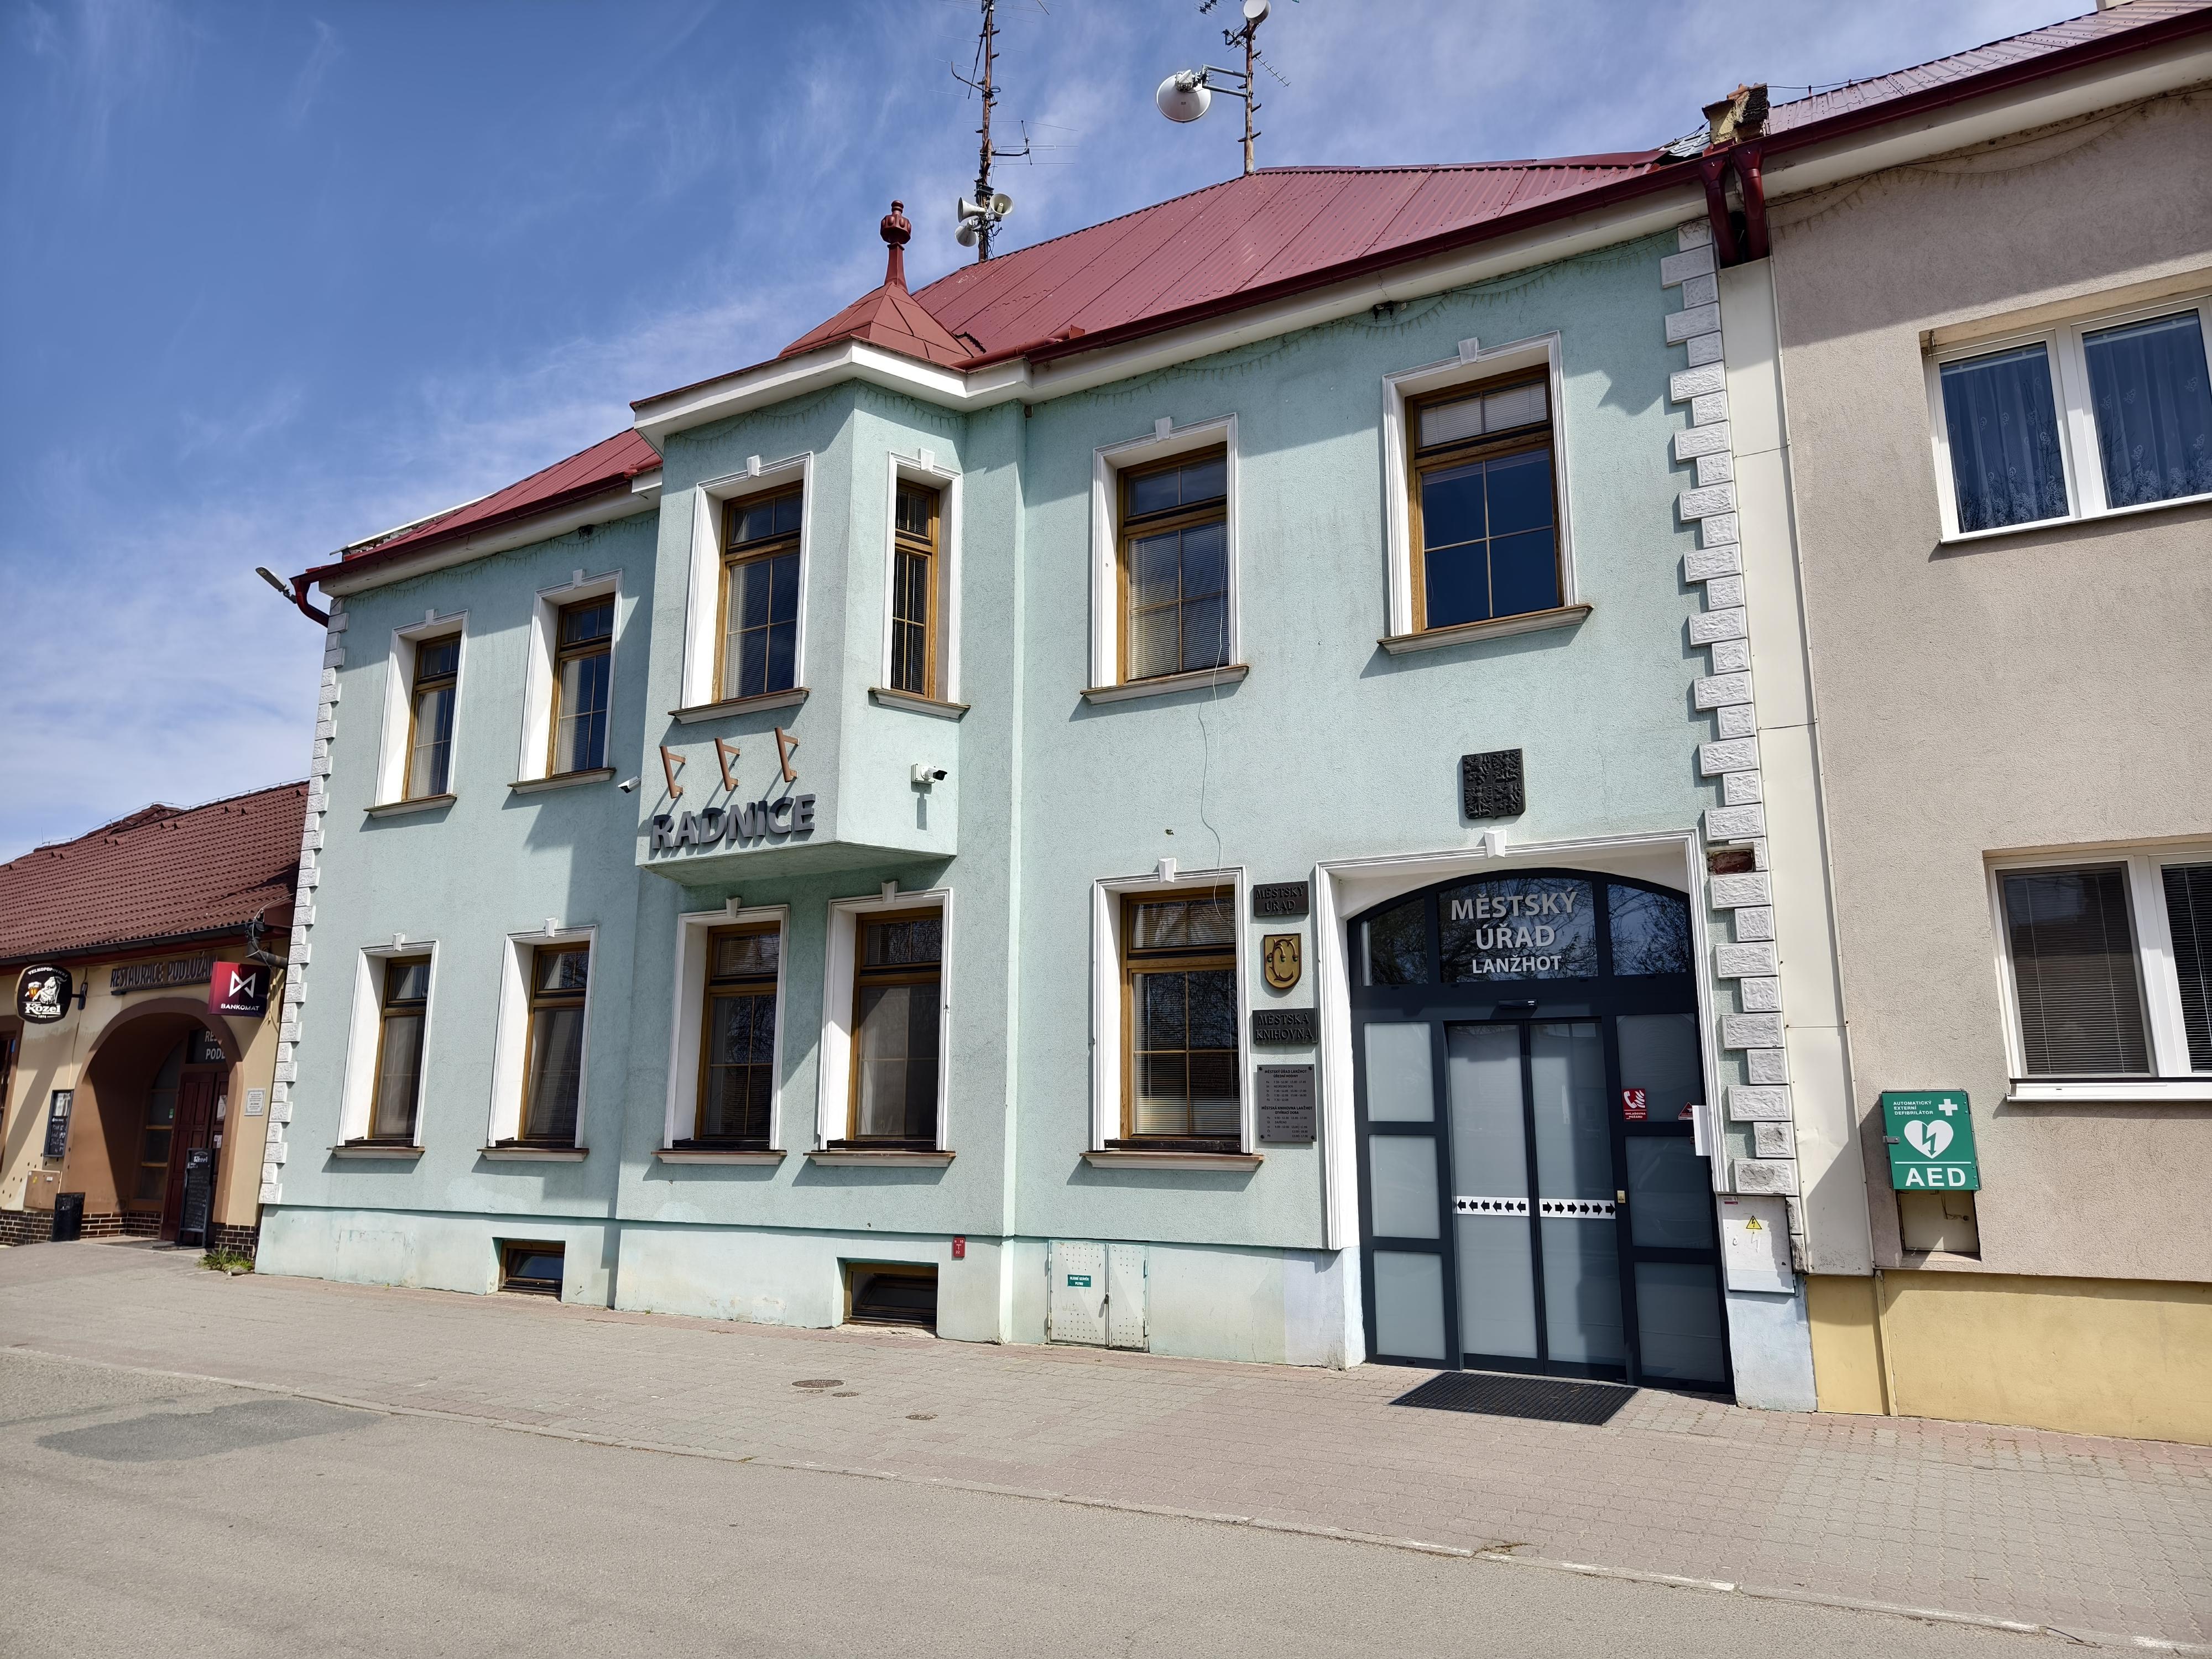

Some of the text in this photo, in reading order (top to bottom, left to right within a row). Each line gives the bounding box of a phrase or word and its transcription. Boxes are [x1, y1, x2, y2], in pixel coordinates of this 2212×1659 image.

[651, 794, 816, 850] RADNICE
[1255, 885, 1305, 900] MĚSTSKÝ
[1265, 899, 1296, 912] ÚŘAD
[1451, 887, 1577, 920] MĚSTSKÝ
[1476, 923, 1555, 950] ÚŘAD
[1472, 954, 1562, 974] LANŽHOT
[110, 962, 165, 988] RESTAURACE
[24, 1003, 61, 1015] Kozel
[1258, 1011, 1310, 1026] MĚSTSKÁ
[1256, 1028, 1314, 1040] KNIHOVNA
[1905, 1167, 1966, 1187] AED
